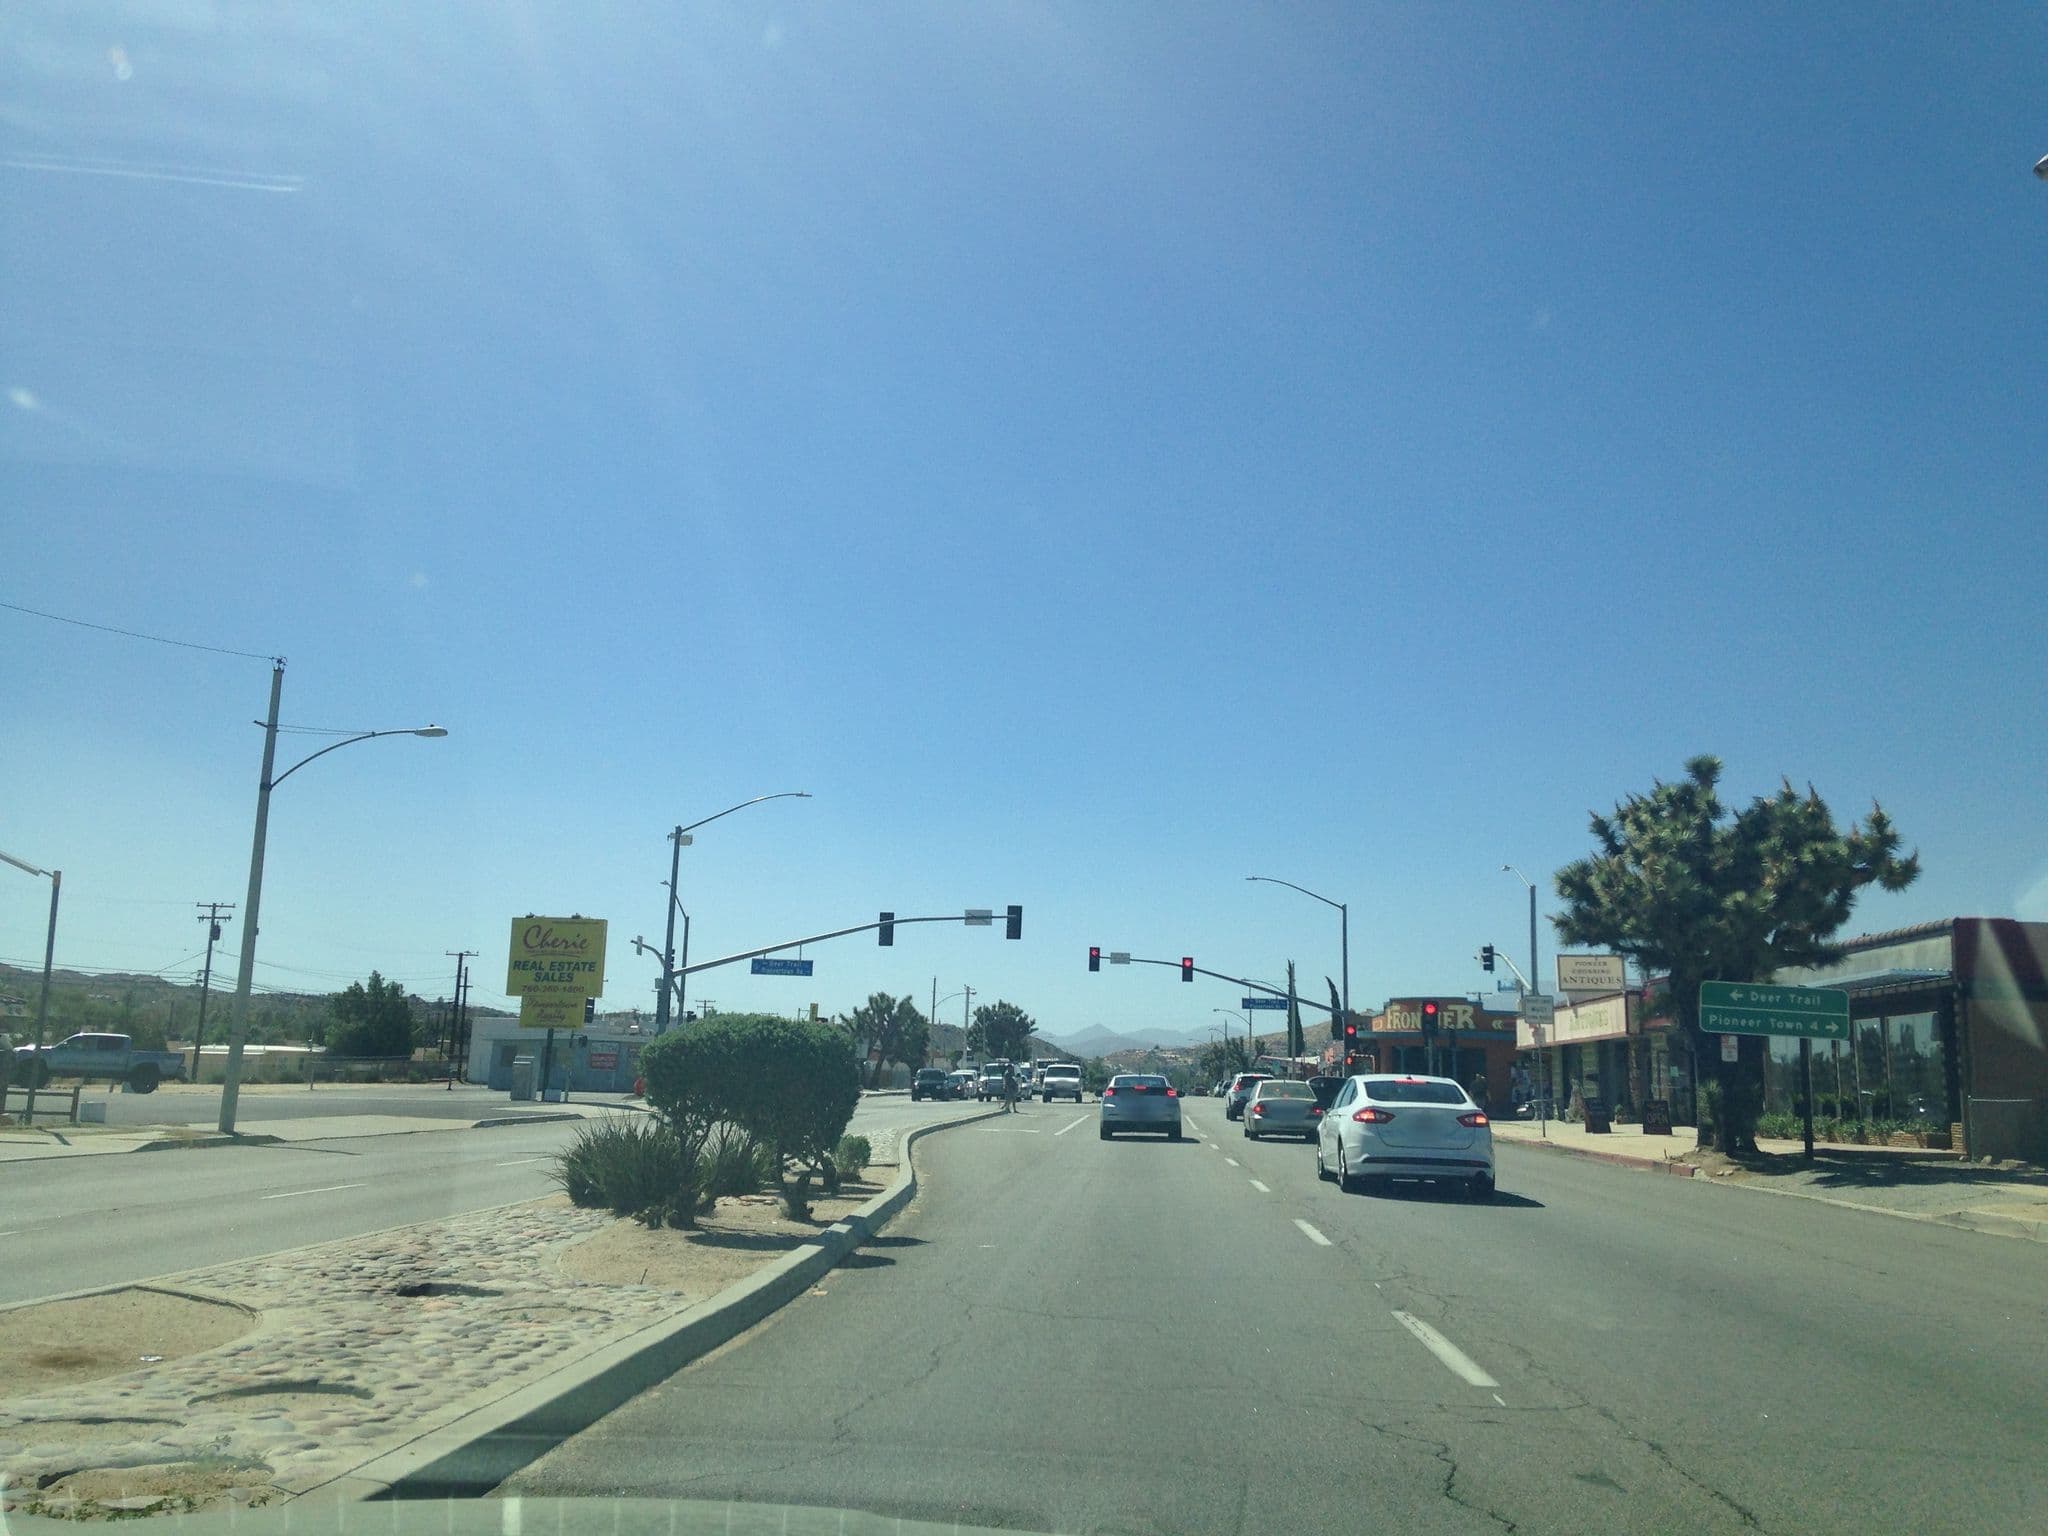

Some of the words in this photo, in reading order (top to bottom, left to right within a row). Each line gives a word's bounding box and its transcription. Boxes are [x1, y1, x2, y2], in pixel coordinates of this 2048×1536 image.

[522, 924, 589, 950] Cherie
[513, 960, 545, 971] REAL
[549, 961, 597, 972] ESTATE
[534, 972, 575, 982] SALES
[1562, 976, 1622, 985] ANTIQUES
[1750, 991, 1782, 1003] Deer
[1789, 993, 1821, 1006] Trail
[1386, 1003, 1476, 1030] FRONIER
[1708, 1014, 1762, 1028] Pioneer
[1770, 1018, 1803, 1031] Town
